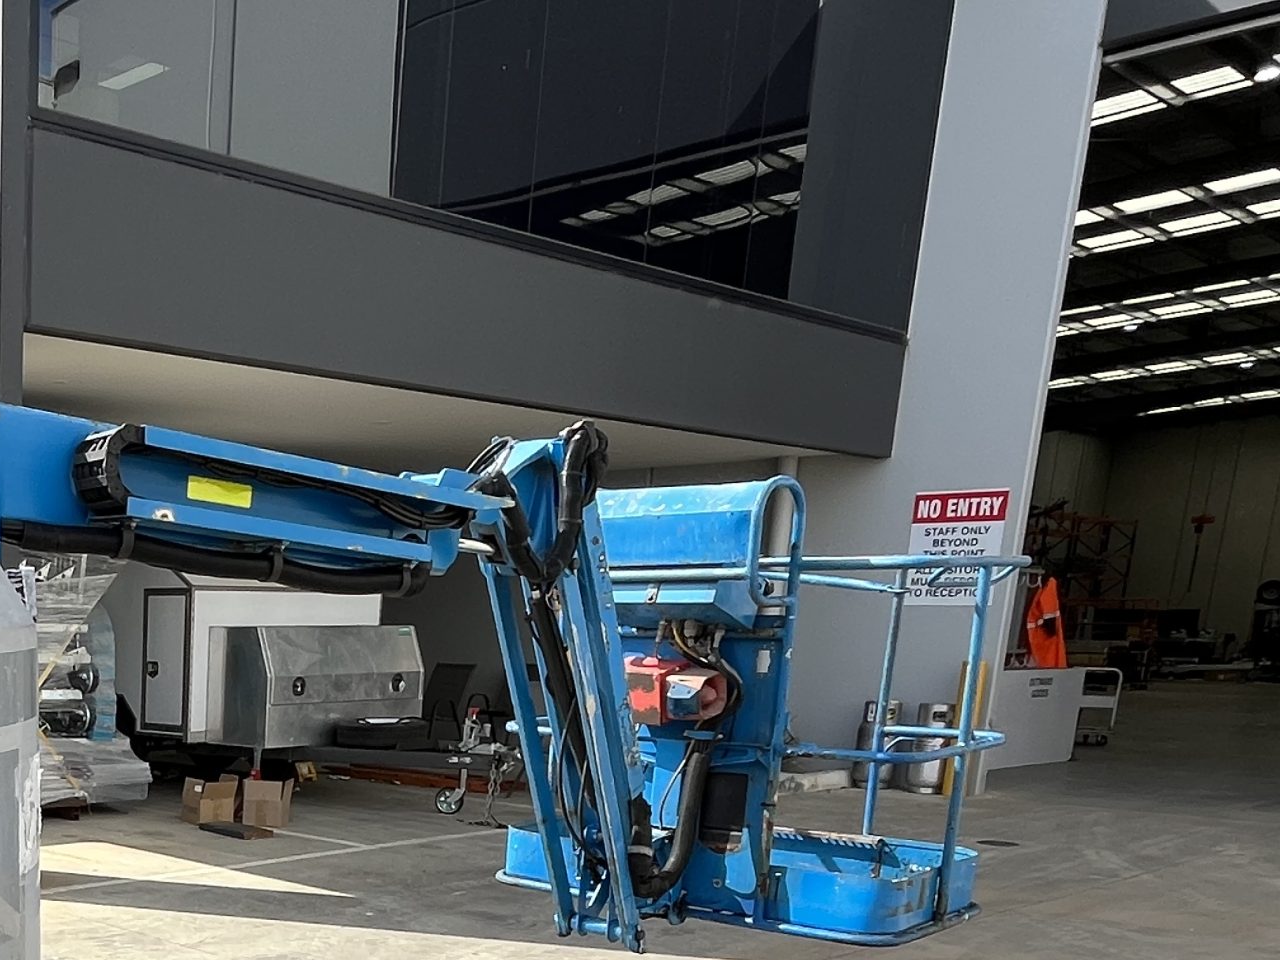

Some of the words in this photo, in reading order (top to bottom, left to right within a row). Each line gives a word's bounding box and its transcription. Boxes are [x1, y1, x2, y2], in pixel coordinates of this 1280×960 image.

[917, 499, 942, 519] NO
[946, 496, 1004, 517] ENTRY
[924, 527, 958, 537] STAFF
[961, 526, 991, 536] ONLY
[932, 538, 978, 548] BEYOND
[925, 588, 978, 597] RECEPTI
